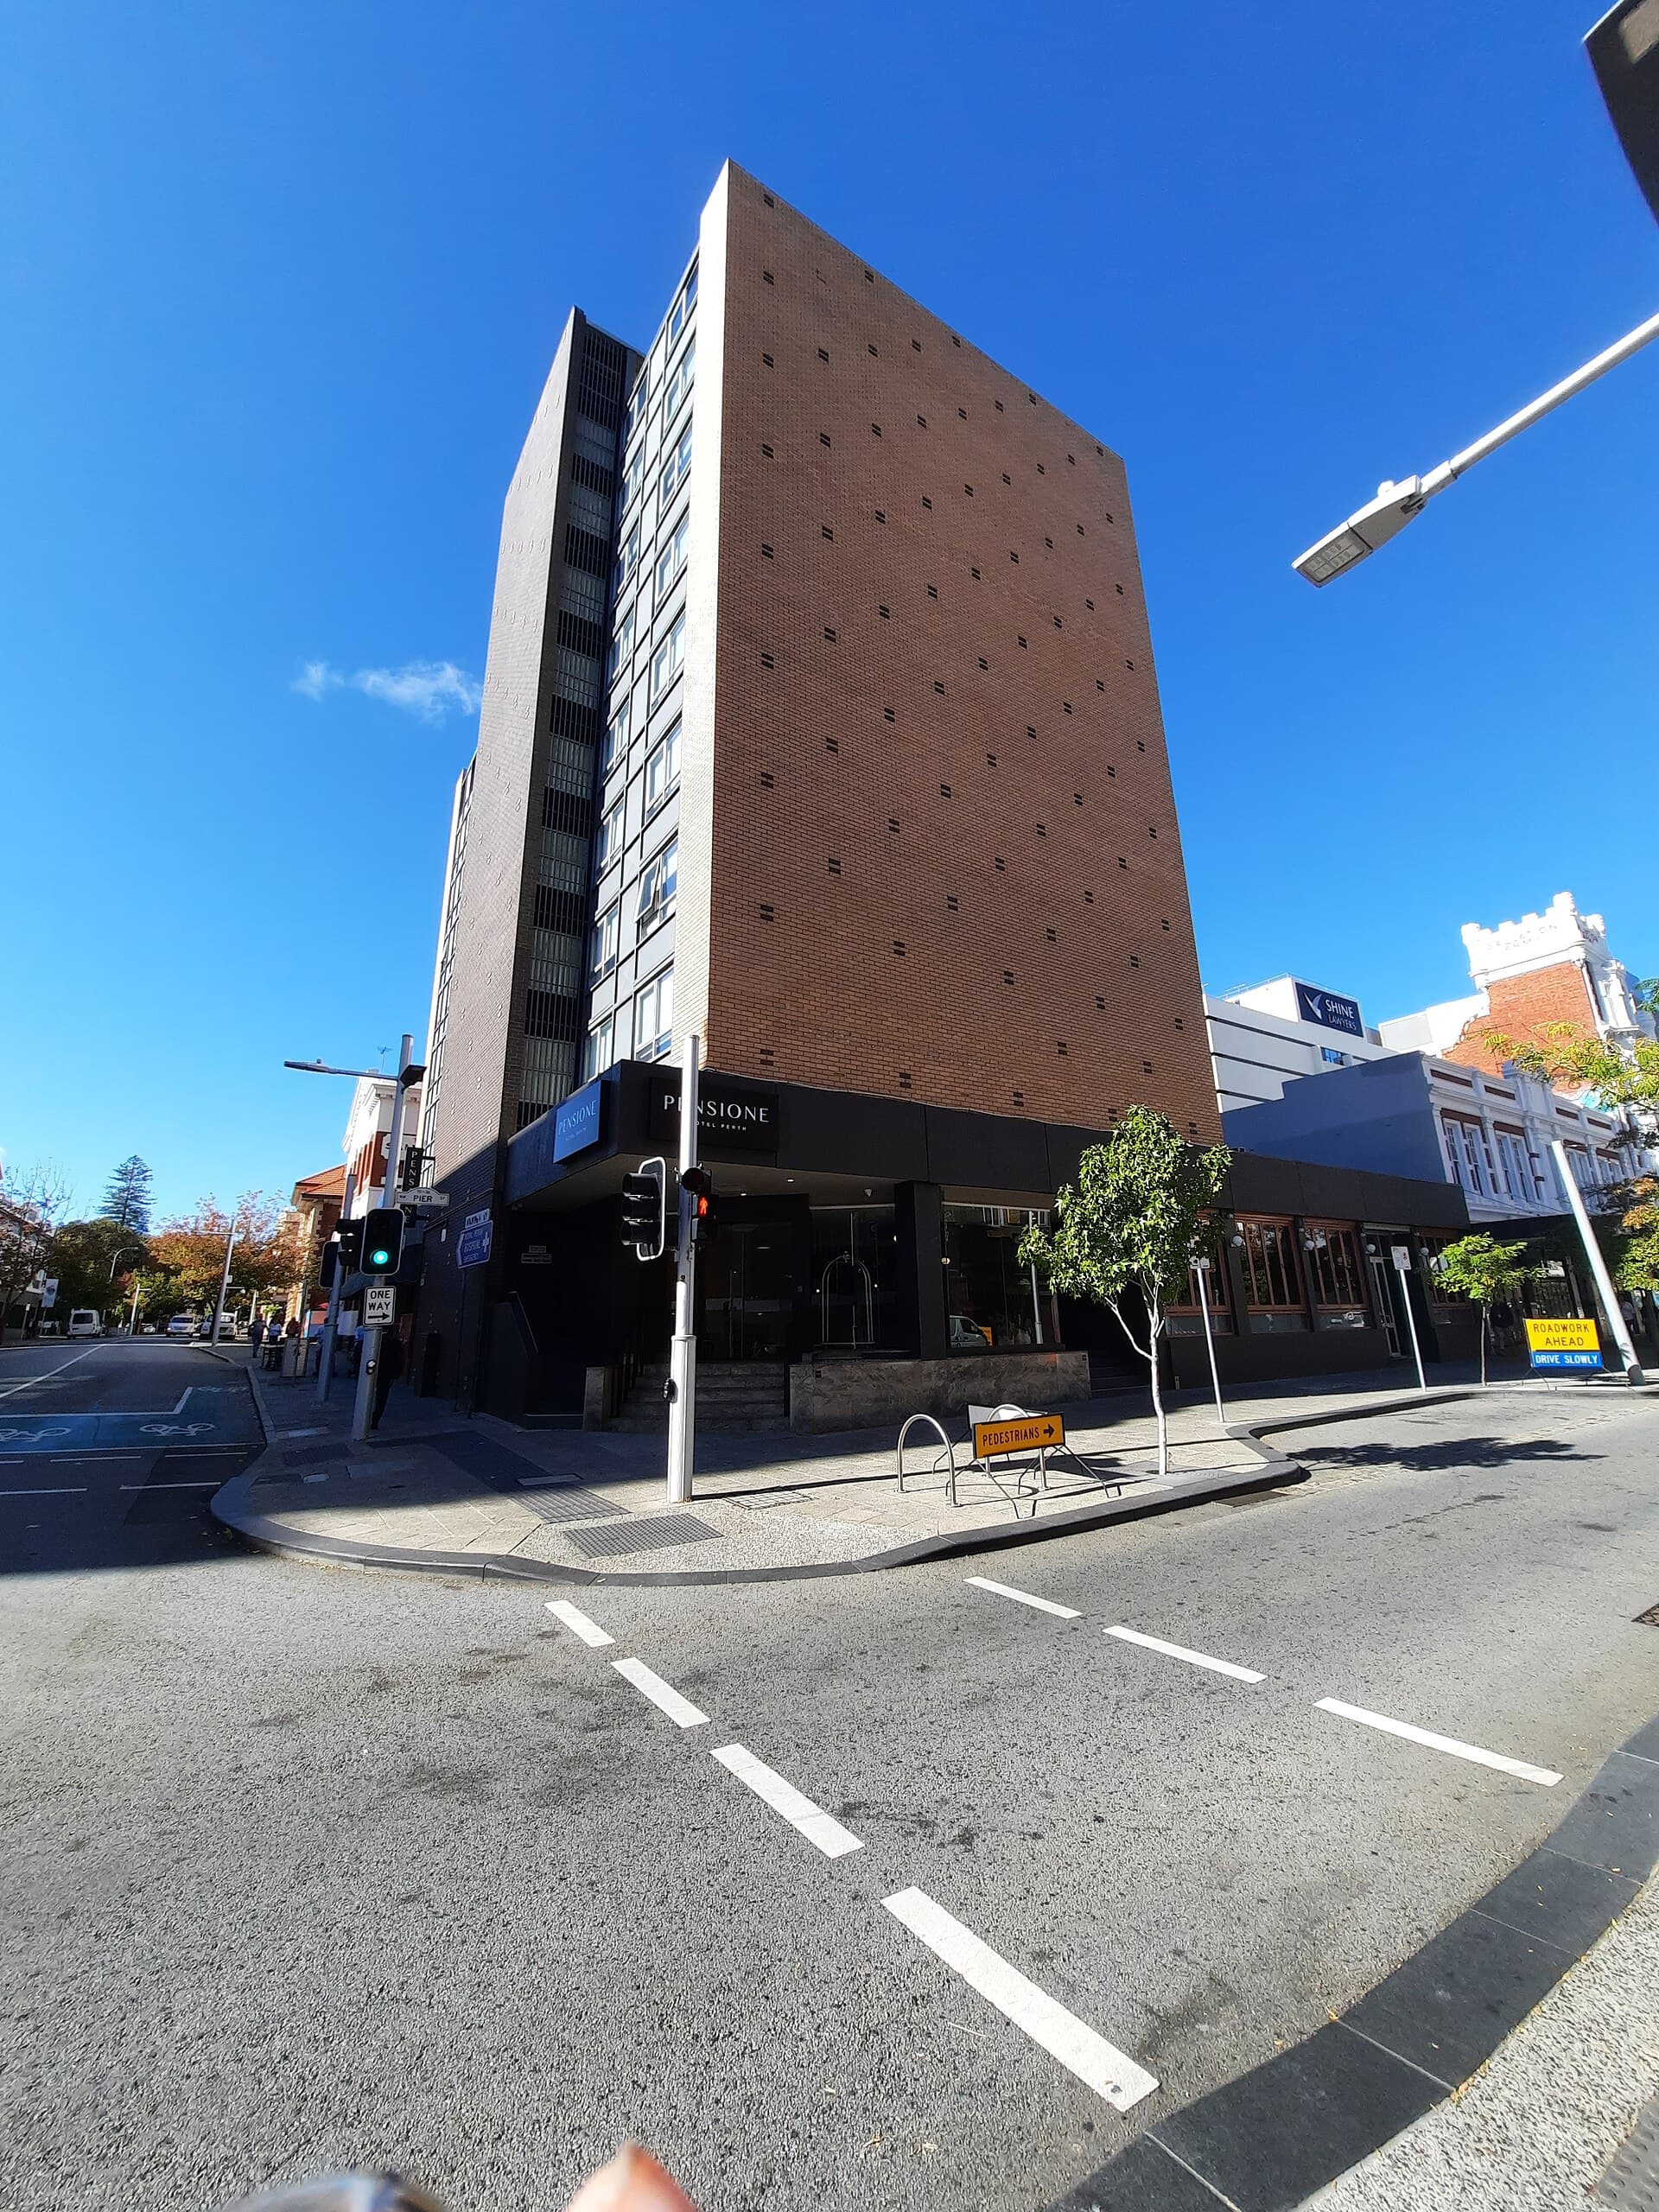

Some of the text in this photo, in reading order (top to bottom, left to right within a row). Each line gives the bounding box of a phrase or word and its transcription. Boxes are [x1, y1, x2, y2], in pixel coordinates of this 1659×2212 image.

[1325, 999, 1355, 1020] SHINE
[1328, 1014, 1357, 1031] LAWYERS
[558, 1099, 597, 1135] PENSIONE
[413, 1194, 433, 1203] PIER
[370, 1290, 391, 1300] ONE
[368, 1301, 391, 1311] WAY
[1533, 1323, 1590, 1333] ROADWORK
[1545, 1337, 1585, 1346] AHEAD
[1535, 1354, 1598, 1364] DRIVE SLOWLY
[982, 1427, 1040, 1447] PEDESTRIANS
